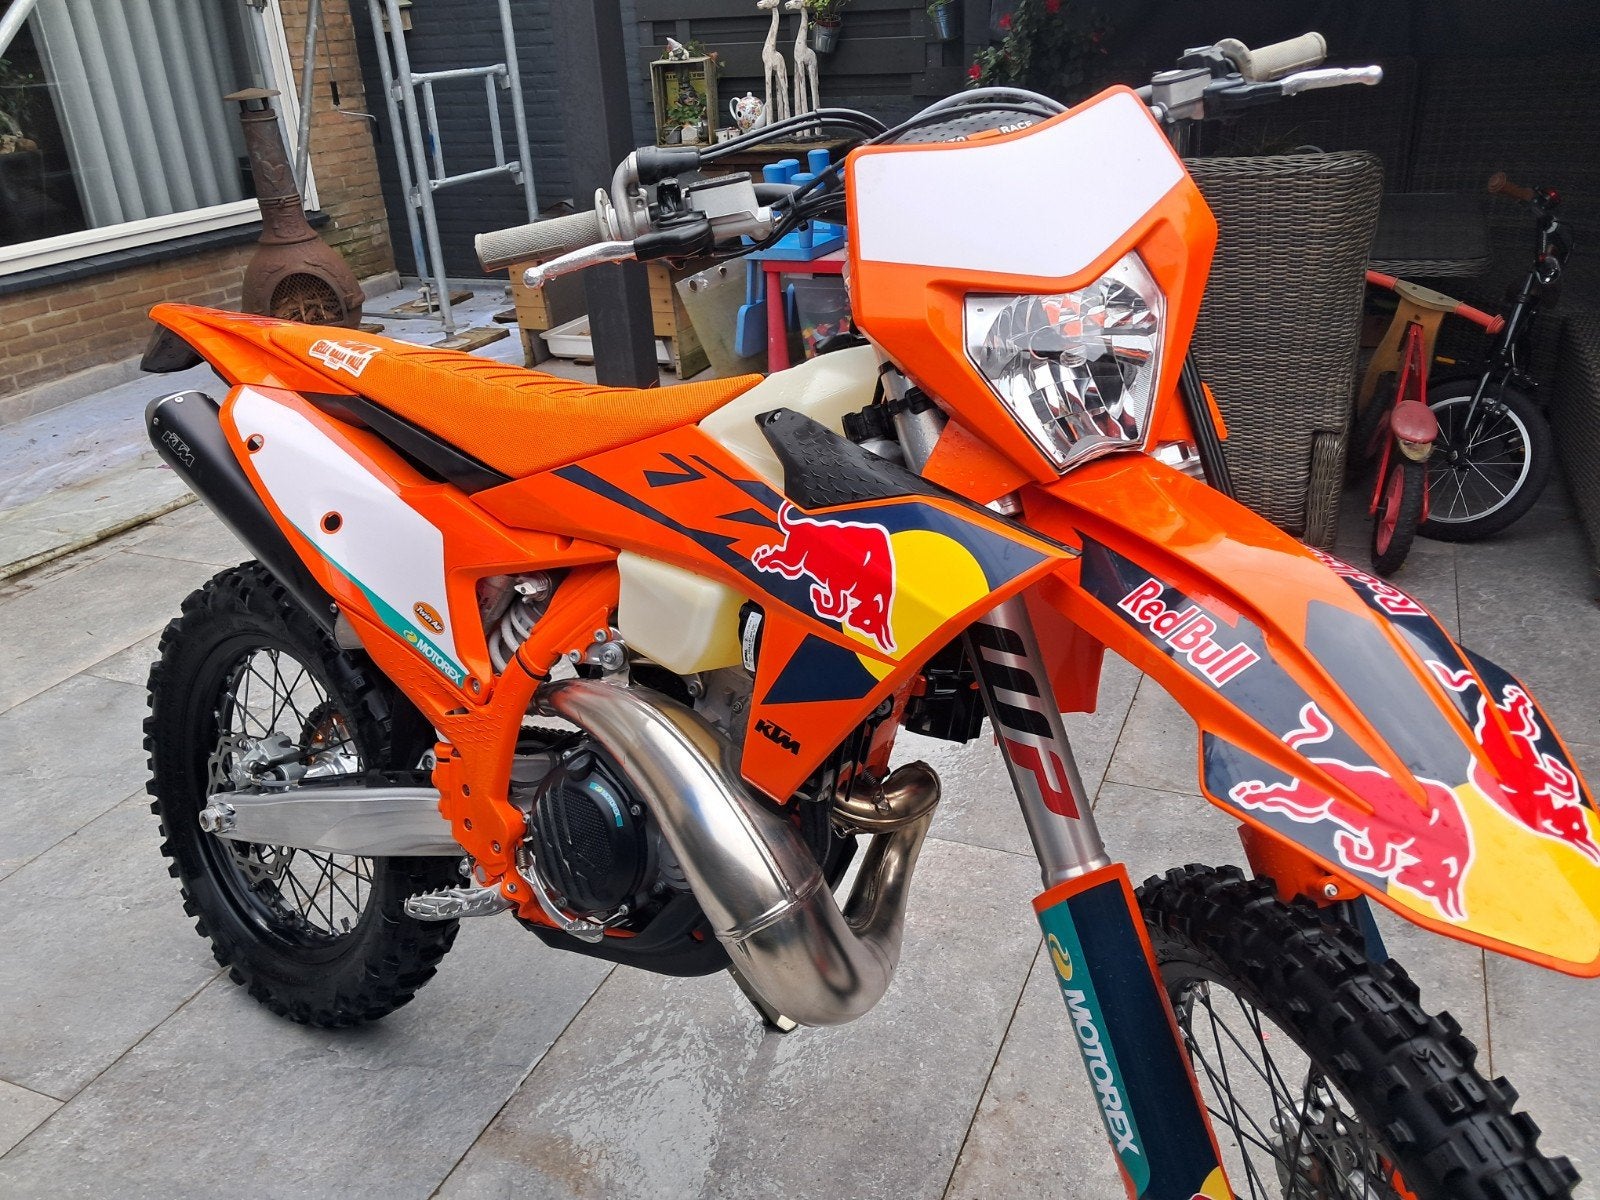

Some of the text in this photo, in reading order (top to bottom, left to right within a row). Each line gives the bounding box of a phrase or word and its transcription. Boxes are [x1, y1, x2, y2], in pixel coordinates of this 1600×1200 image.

[161, 430, 195, 468] KTM
[415, 605, 444, 631] Twin Air
[416, 638, 461, 685] MOTOREX
[754, 719, 801, 756] KTM
[1064, 989, 1140, 1156] MOTOREX
